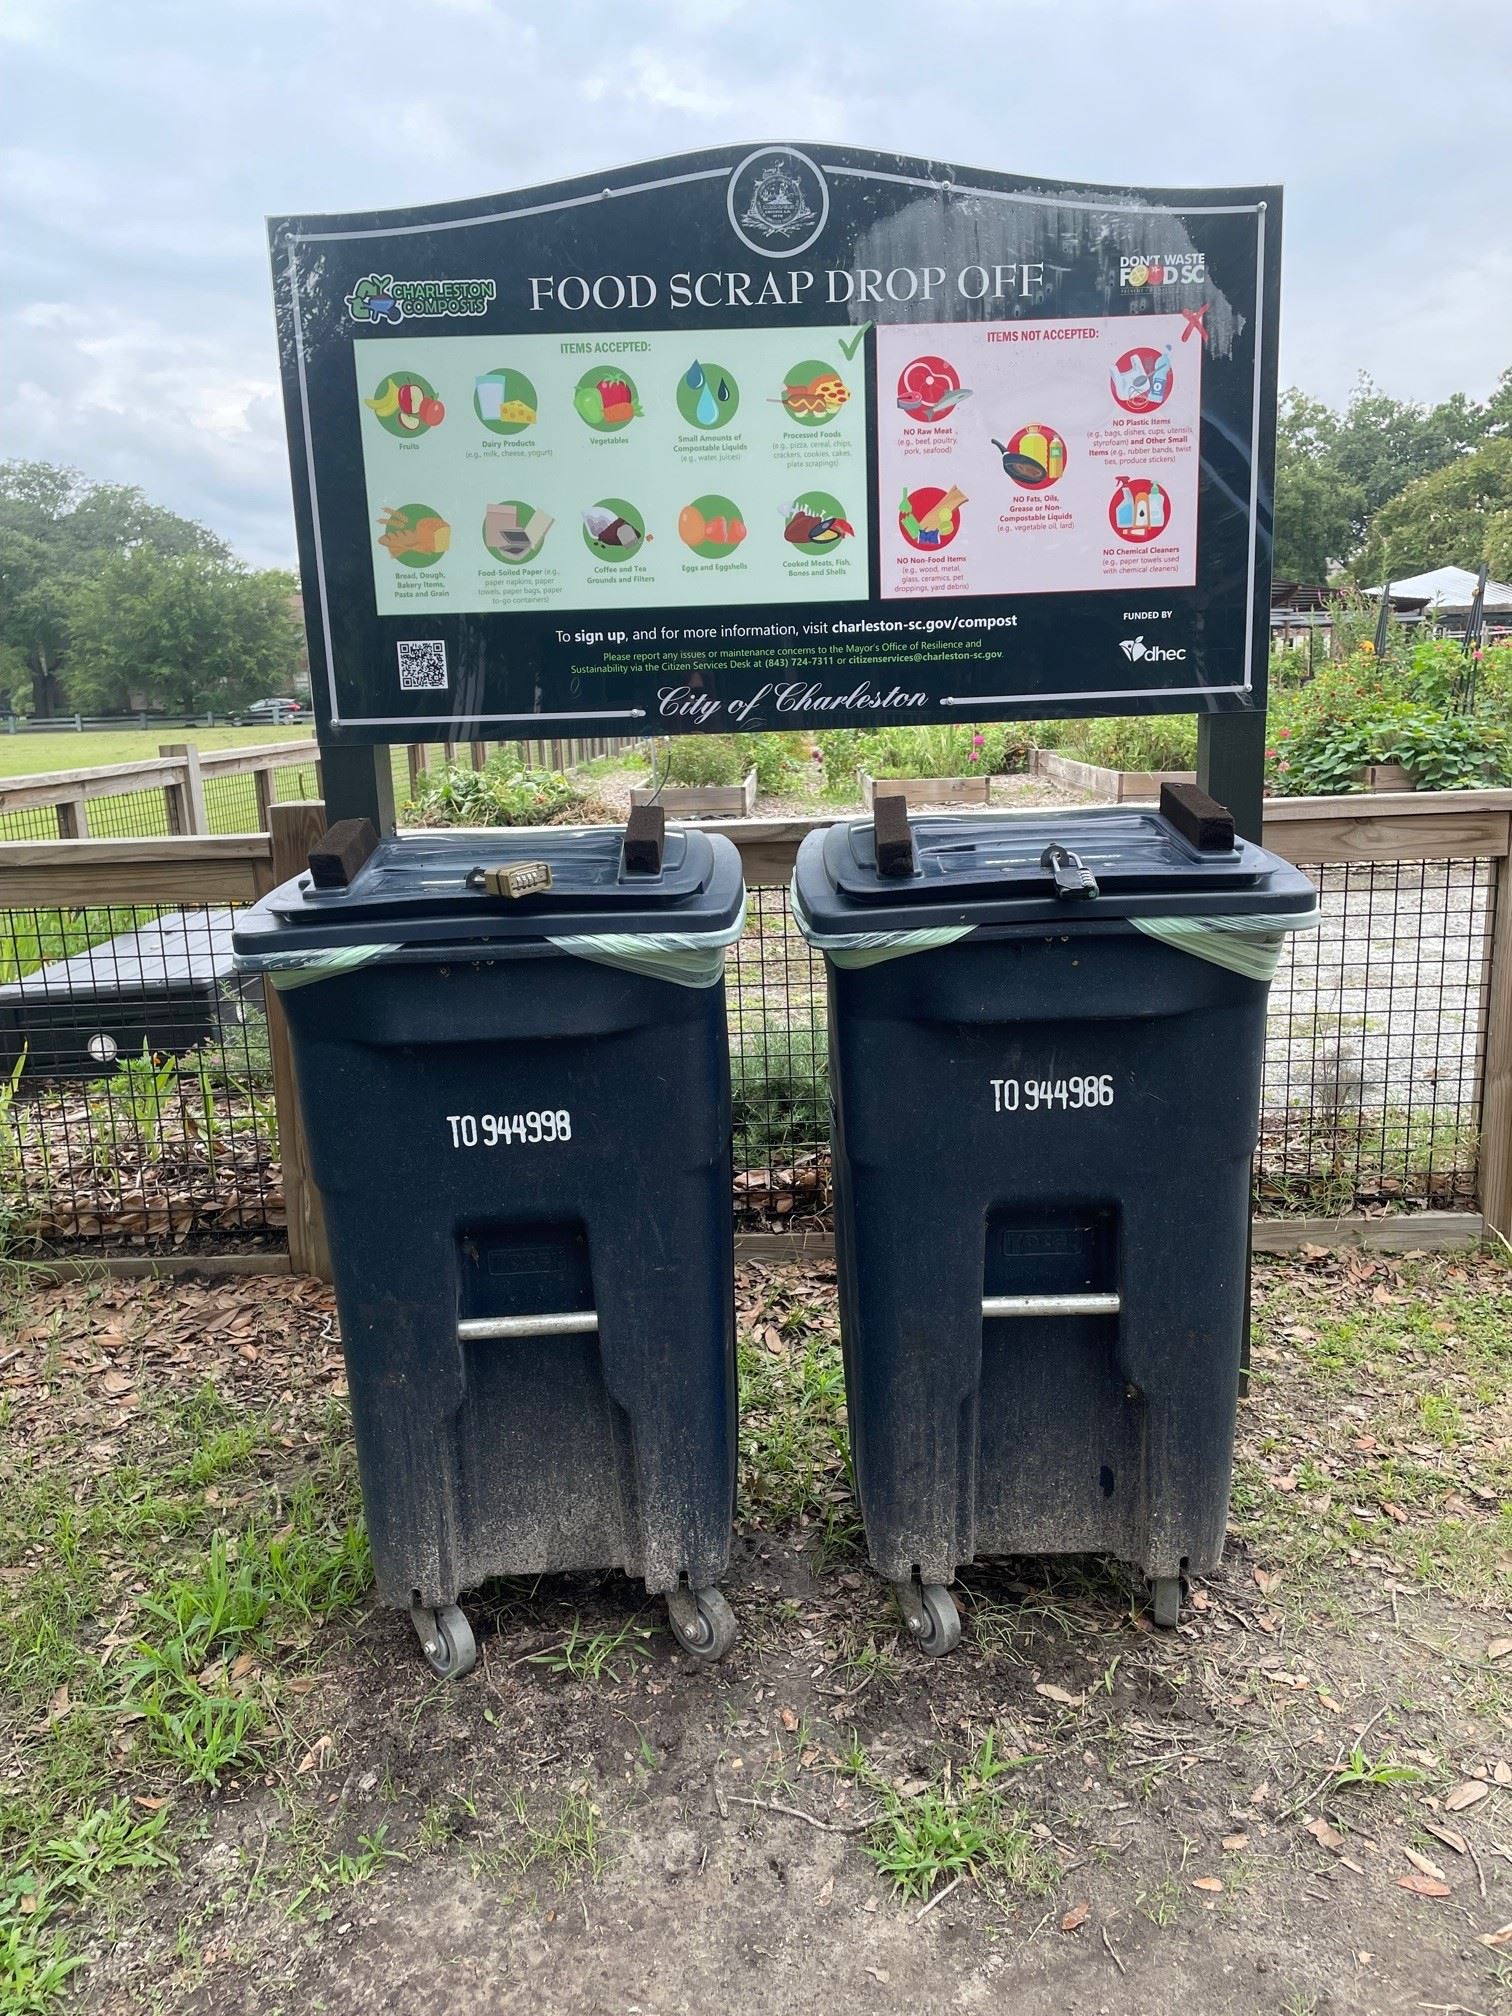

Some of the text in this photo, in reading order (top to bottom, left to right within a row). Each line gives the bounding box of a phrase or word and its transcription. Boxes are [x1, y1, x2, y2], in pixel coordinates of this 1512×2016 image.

[1120, 253, 1205, 268] DON'T WASTE
[1180, 265, 1205, 284] SC
[392, 282, 494, 299] CHARLESTON
[528, 262, 1044, 311] FOOD SCRAP DROP OFF
[403, 299, 484, 315] COMPOSTS
[987, 327, 1099, 343] ITEMS NOT ACCEPTED:
[560, 341, 651, 355] ITEMS ACCEPTED:
[903, 428, 915, 436] NO
[934, 427, 953, 435] Meat
[589, 437, 629, 445] Vegetables
[700, 434, 732, 442] Amounts
[482, 440, 502, 449] Dairy
[673, 443, 748, 453] Compostable Liquids
[1093, 439, 1130, 448] styrofoam)
[904, 446, 952, 456] pork, seafood)
[1127, 447, 1150, 455] rubber
[1175, 445, 1192, 453] twist
[1119, 457, 1147, 466] produce
[1148, 455, 1176, 463] stickers)
[999, 512, 1072, 523] Compostable Liquids
[1014, 521, 1075, 532] vegetable lard)
[782, 559, 851, 568] Cooked Meats, Fish,
[1119, 558, 1139, 566] paper
[1140, 556, 1162, 564] towels
[594, 565, 647, 574] Coffee and Tea
[682, 562, 748, 573] Eggs and Eggshells
[788, 567, 846, 577] Bones and Shells
[1119, 566, 1148, 574] chemical
[420, 572, 446, 580] Dough,
[478, 569, 542, 577] Food-Soiled Paper
[952, 574, 964, 582] pet
[586, 575, 655, 584] Grounds and Filters
[397, 581, 422, 590] Bakery
[930, 584, 945, 592] yard
[1123, 610, 1173, 620] FUNDED BY
[555, 614, 1018, 645] To sign up, and for more information, visit charleston-sc.gov/compost
[603, 639, 982, 662] Please report any issues or maintenance concerns to the Mayor's Office of Resilience and
[1144, 646, 1187, 661] dhec
[570, 664, 629, 675] Sustainability
[630, 664, 643, 672] via
[645, 663, 659, 672] the
[661, 662, 691, 671] Citizen
[693, 661, 728, 670] Services
[730, 660, 751, 669] Desk
[753, 660, 762, 668] at
[765, 658, 789, 669] (843)
[791, 656, 833, 666] 724-7311
[657, 680, 928, 725] City of Charleston
[1024, 1074, 1114, 1111] 944986
[481, 1109, 572, 1146] 944998
